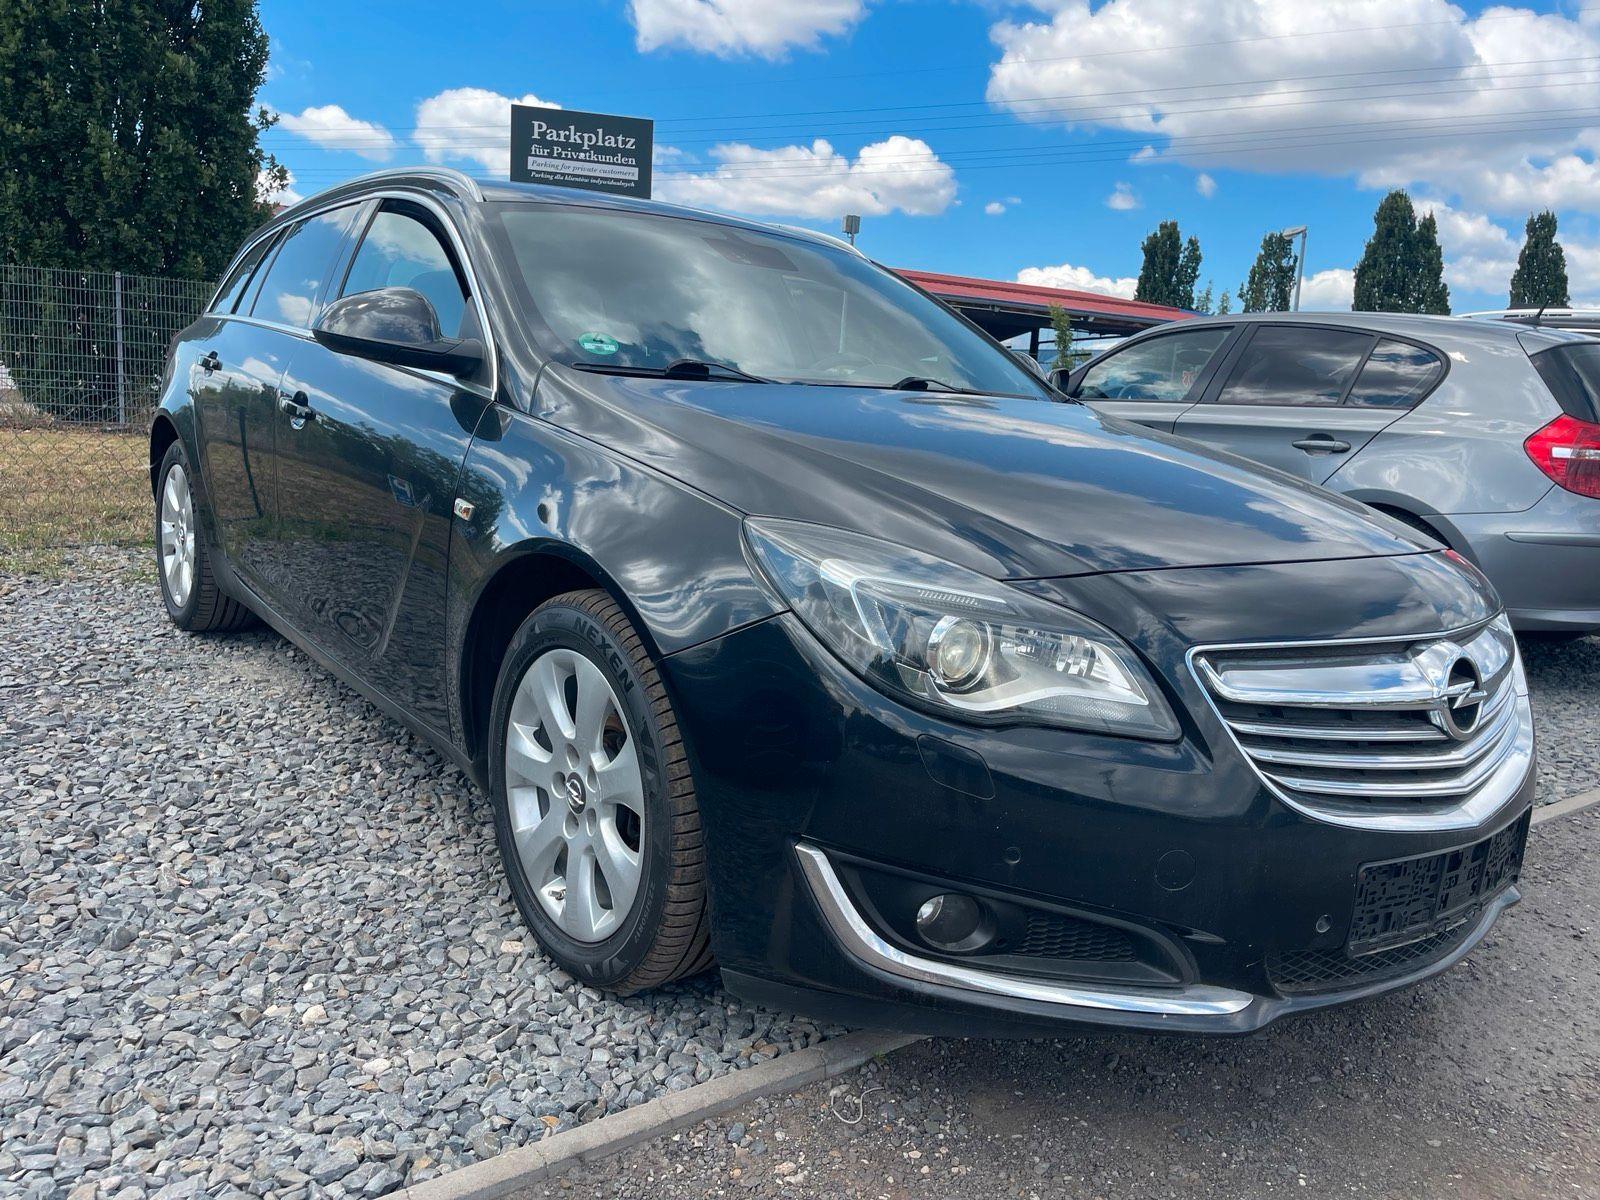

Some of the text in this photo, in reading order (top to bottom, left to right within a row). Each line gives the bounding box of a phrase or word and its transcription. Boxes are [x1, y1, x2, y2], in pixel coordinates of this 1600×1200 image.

[531, 120, 636, 149] Parkplatz
[531, 144, 636, 165] für Privatkunden
[530, 171, 554, 180] Parking
[531, 159, 635, 177] Parking for private customers
[573, 616, 635, 693] NEXEN
